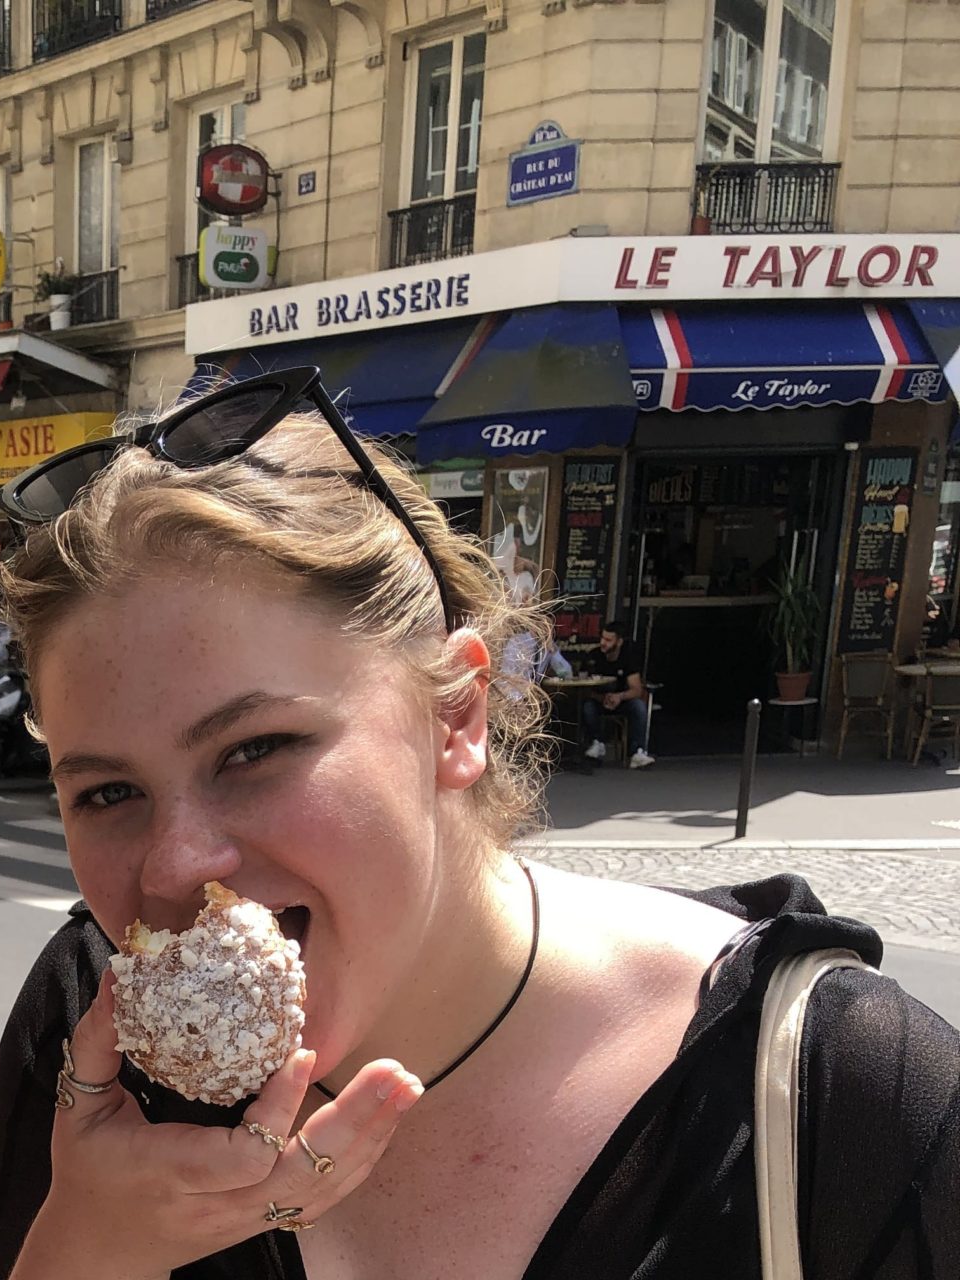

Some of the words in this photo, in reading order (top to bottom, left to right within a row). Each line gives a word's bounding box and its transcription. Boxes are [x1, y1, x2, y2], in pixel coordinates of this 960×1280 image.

[526, 160, 545, 174] RUE
[547, 157, 561, 169] DU
[550, 171, 575, 185] D'EAU
[216, 227, 259, 251] happy
[217, 260, 240, 273] PMU
[614, 247, 678, 289] LE
[722, 245, 939, 288] TAYLOR
[249, 302, 299, 337] BAR
[316, 273, 471, 327] BRASSERIE
[731, 380, 760, 401] Le
[764, 378, 831, 401] Taylor
[481, 424, 547, 447] Bar
